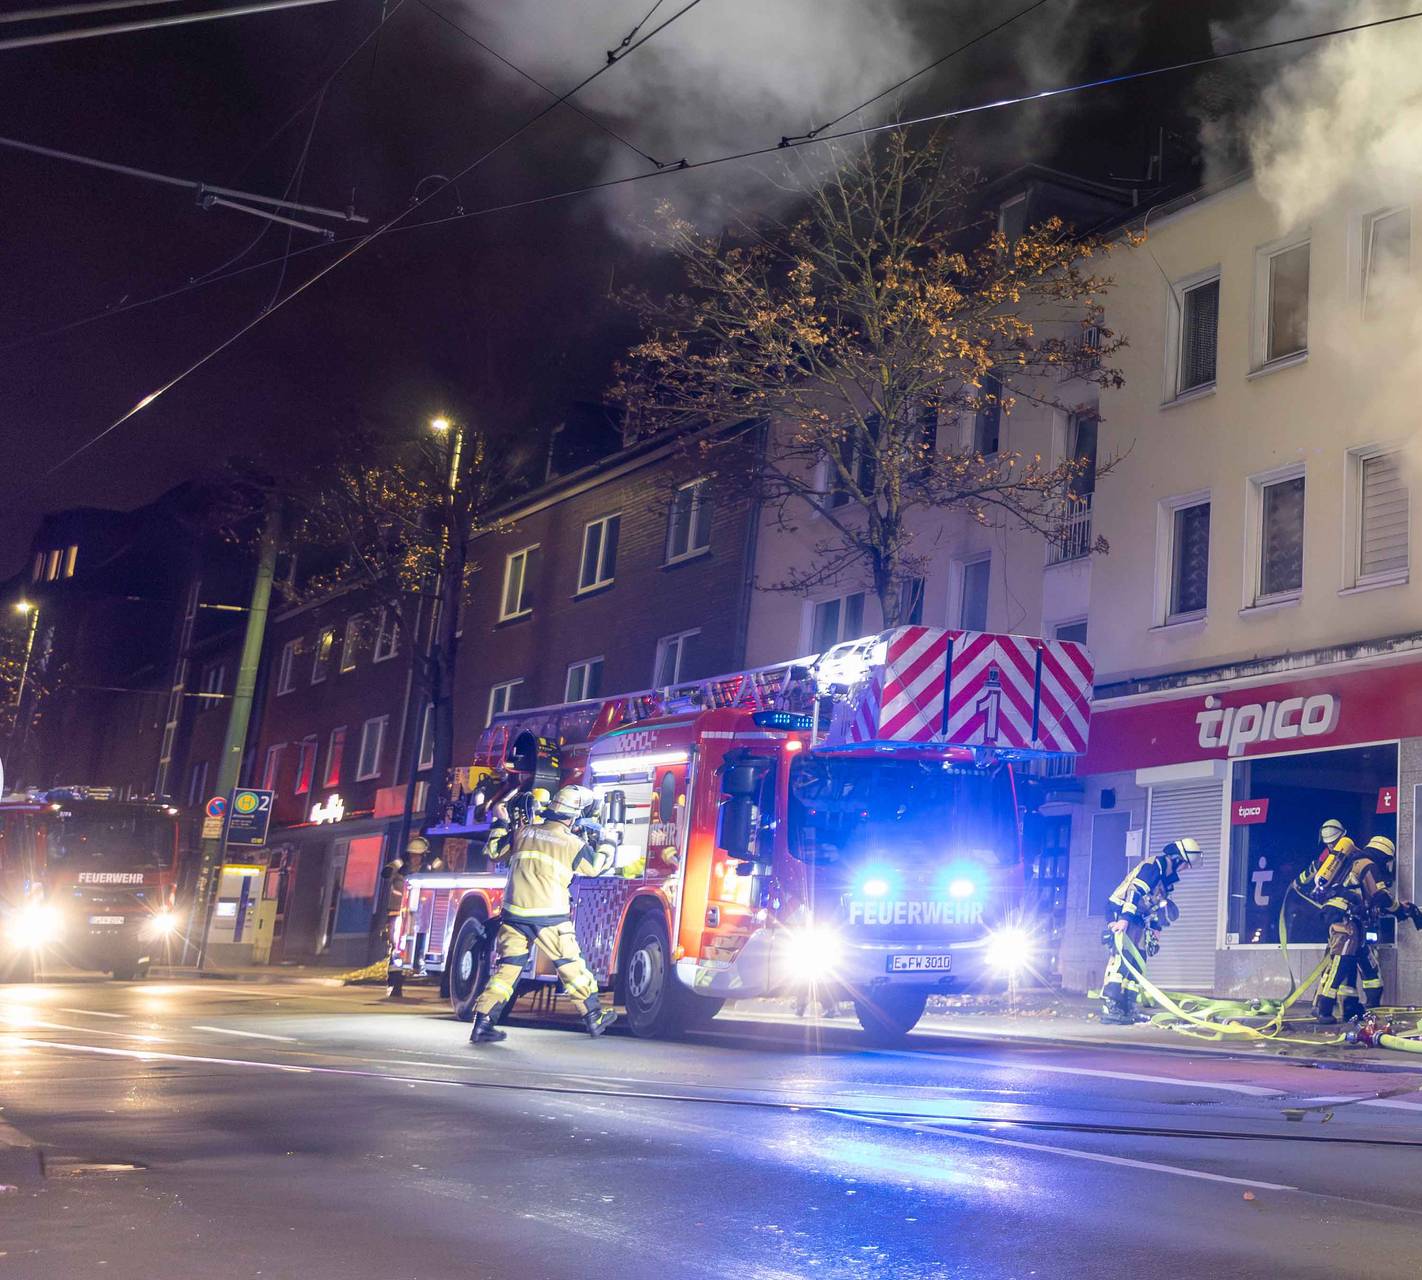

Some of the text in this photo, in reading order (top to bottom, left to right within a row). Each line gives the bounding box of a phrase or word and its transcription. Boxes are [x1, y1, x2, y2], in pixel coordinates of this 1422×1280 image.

[976, 689, 1000, 742] 1
[1195, 693, 1338, 757] tipico
[257, 795, 269, 812] 2
[1238, 805, 1261, 818] tipico
[78, 872, 143, 884] FEUERWEHR
[849, 901, 984, 925] FEUERWEHR
[908, 957, 923, 968] FW
[925, 956, 950, 968] 3010
